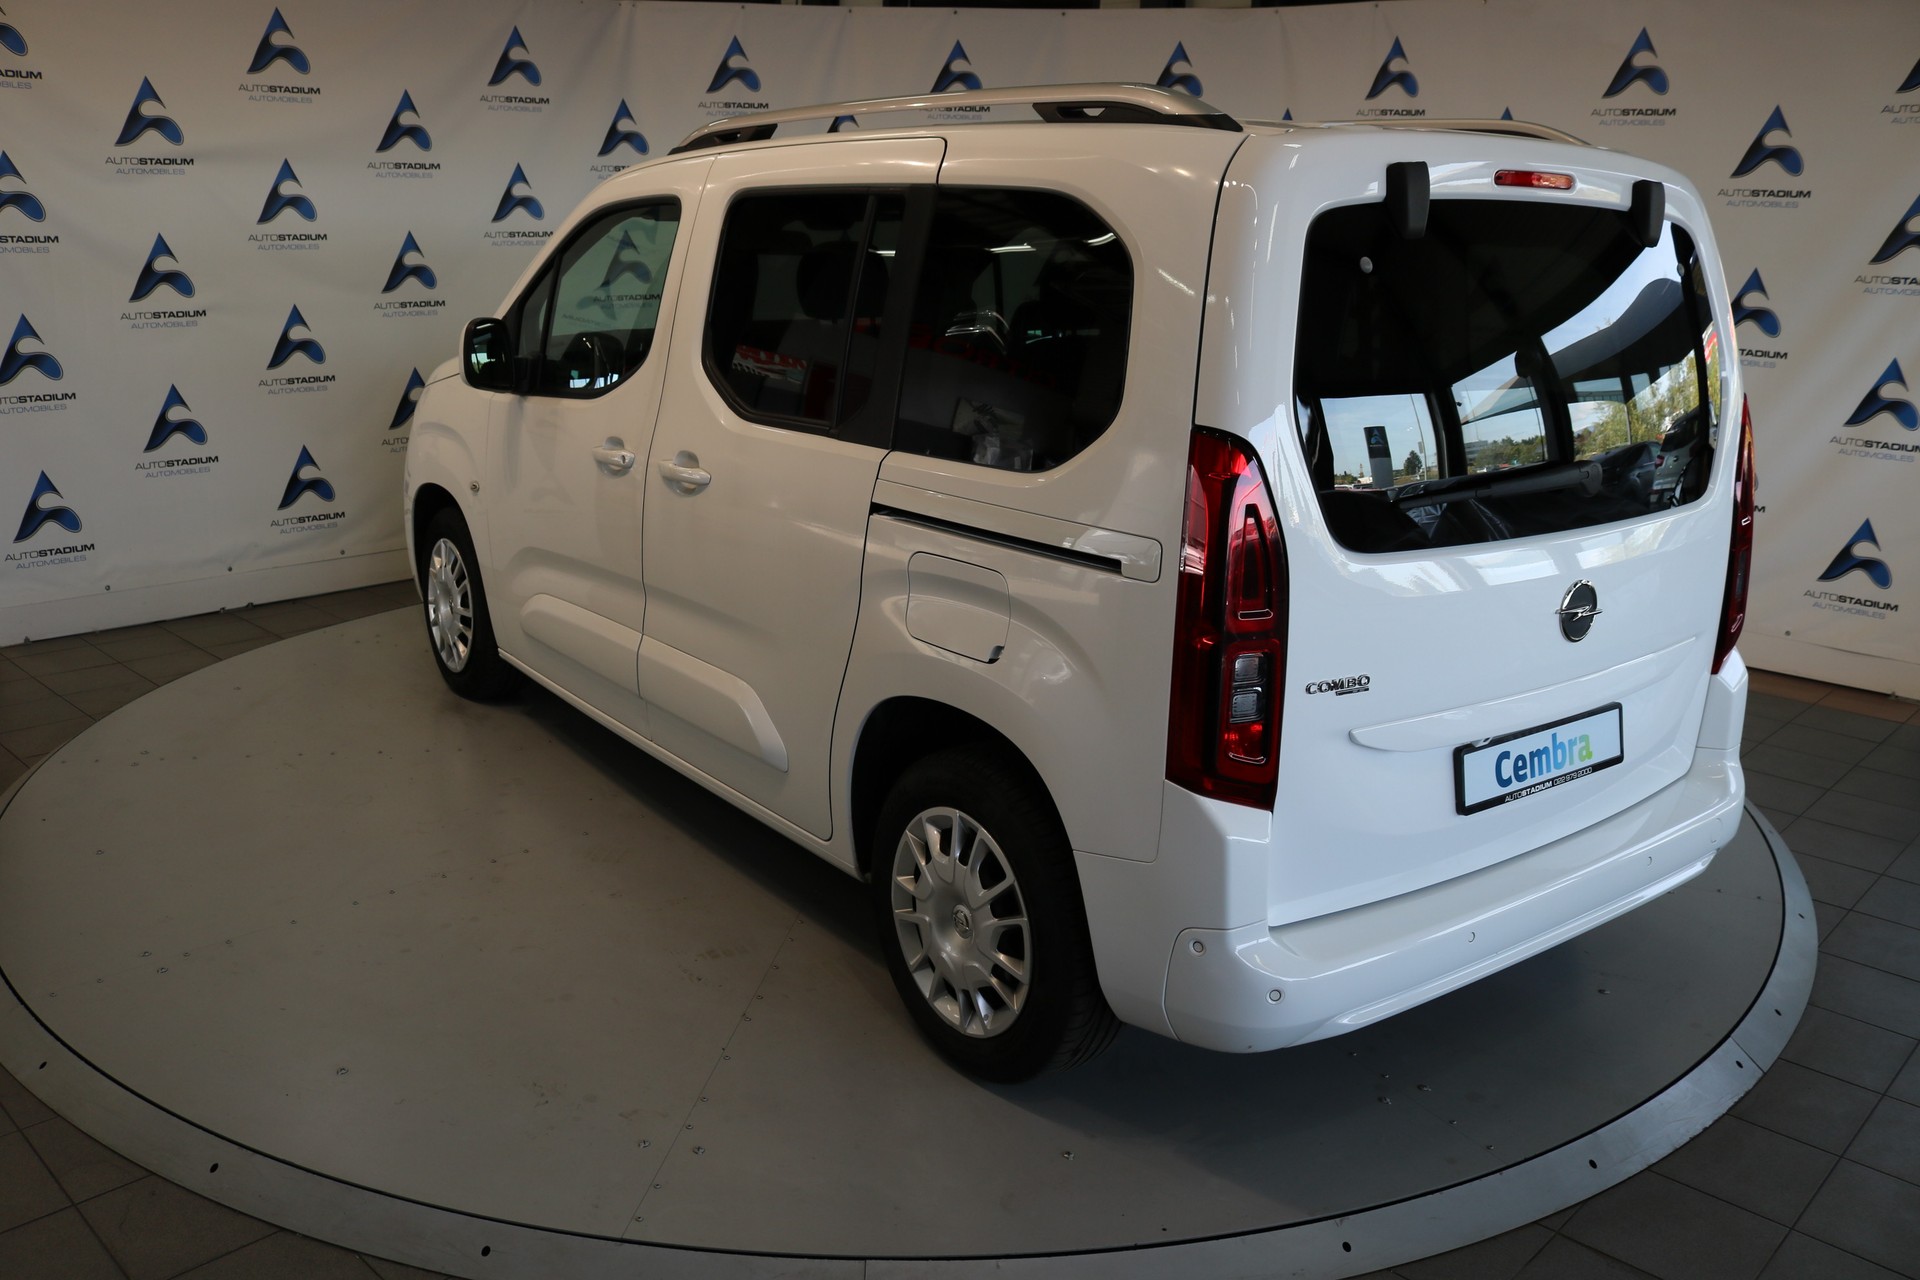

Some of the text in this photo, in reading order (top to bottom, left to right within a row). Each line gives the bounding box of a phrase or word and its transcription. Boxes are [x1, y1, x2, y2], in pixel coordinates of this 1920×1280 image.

[239, 83, 320, 95] AUTOSTADIUM
[248, 95, 312, 104] AUTOMOBILES
[480, 95, 550, 105] AUTOSTADIUM
[698, 101, 769, 110] AUTOSTADIUM
[1591, 108, 1676, 116] AUTOSTADIUM
[105, 157, 194, 166] AUTOSTADIUM
[367, 161, 440, 171] AUTOSTADIUM
[116, 168, 185, 176] AUTOMOBILES
[1717, 189, 1811, 199] AUTOSTADIUM
[1726, 200, 1798, 208] AUTOMOBILES
[0, 235, 59, 243] STADIUM
[248, 233, 327, 242] AUTOSTADIUM
[484, 231, 554, 239] AUTOSTADIUM
[1854, 275, 1920, 285] AUTOSTA
[1863, 287, 1920, 296] AUTOMOB
[593, 294, 660, 302] AUTOSTADIUM
[374, 299, 445, 310] AUTOSTADIUM
[120, 309, 206, 320] AUTOSTADIUM
[382, 309, 438, 318] AUTOMOBILES
[131, 320, 198, 329] AUTOMOBILES
[1739, 348, 1788, 360] TADIUM
[259, 375, 335, 387] AUTOSTADIUM
[268, 385, 328, 395] AUTOMOBILES
[0, 393, 76, 404] TOSTADIUM
[1838, 448, 1914, 462] AUTOMOBILES
[135, 456, 219, 470] AUTOSTADIUM
[145, 466, 210, 478] AUTOMOBILES
[270, 512, 346, 528] AUTOSTADIUM
[280, 522, 338, 535] AUTOMOBILES
[5, 544, 95, 563] AUTOSTADIUM
[16, 555, 86, 569] AUTOMOBILES
[1804, 590, 1899, 612] AUTOSTADIUM
[1812, 602, 1886, 619] AUTOMOBILES
[1305, 674, 1370, 695] COMBO
[1495, 733, 1593, 788] Cembra
[1505, 767, 1592, 802] AUTOSTADIUM 022 979 2000
